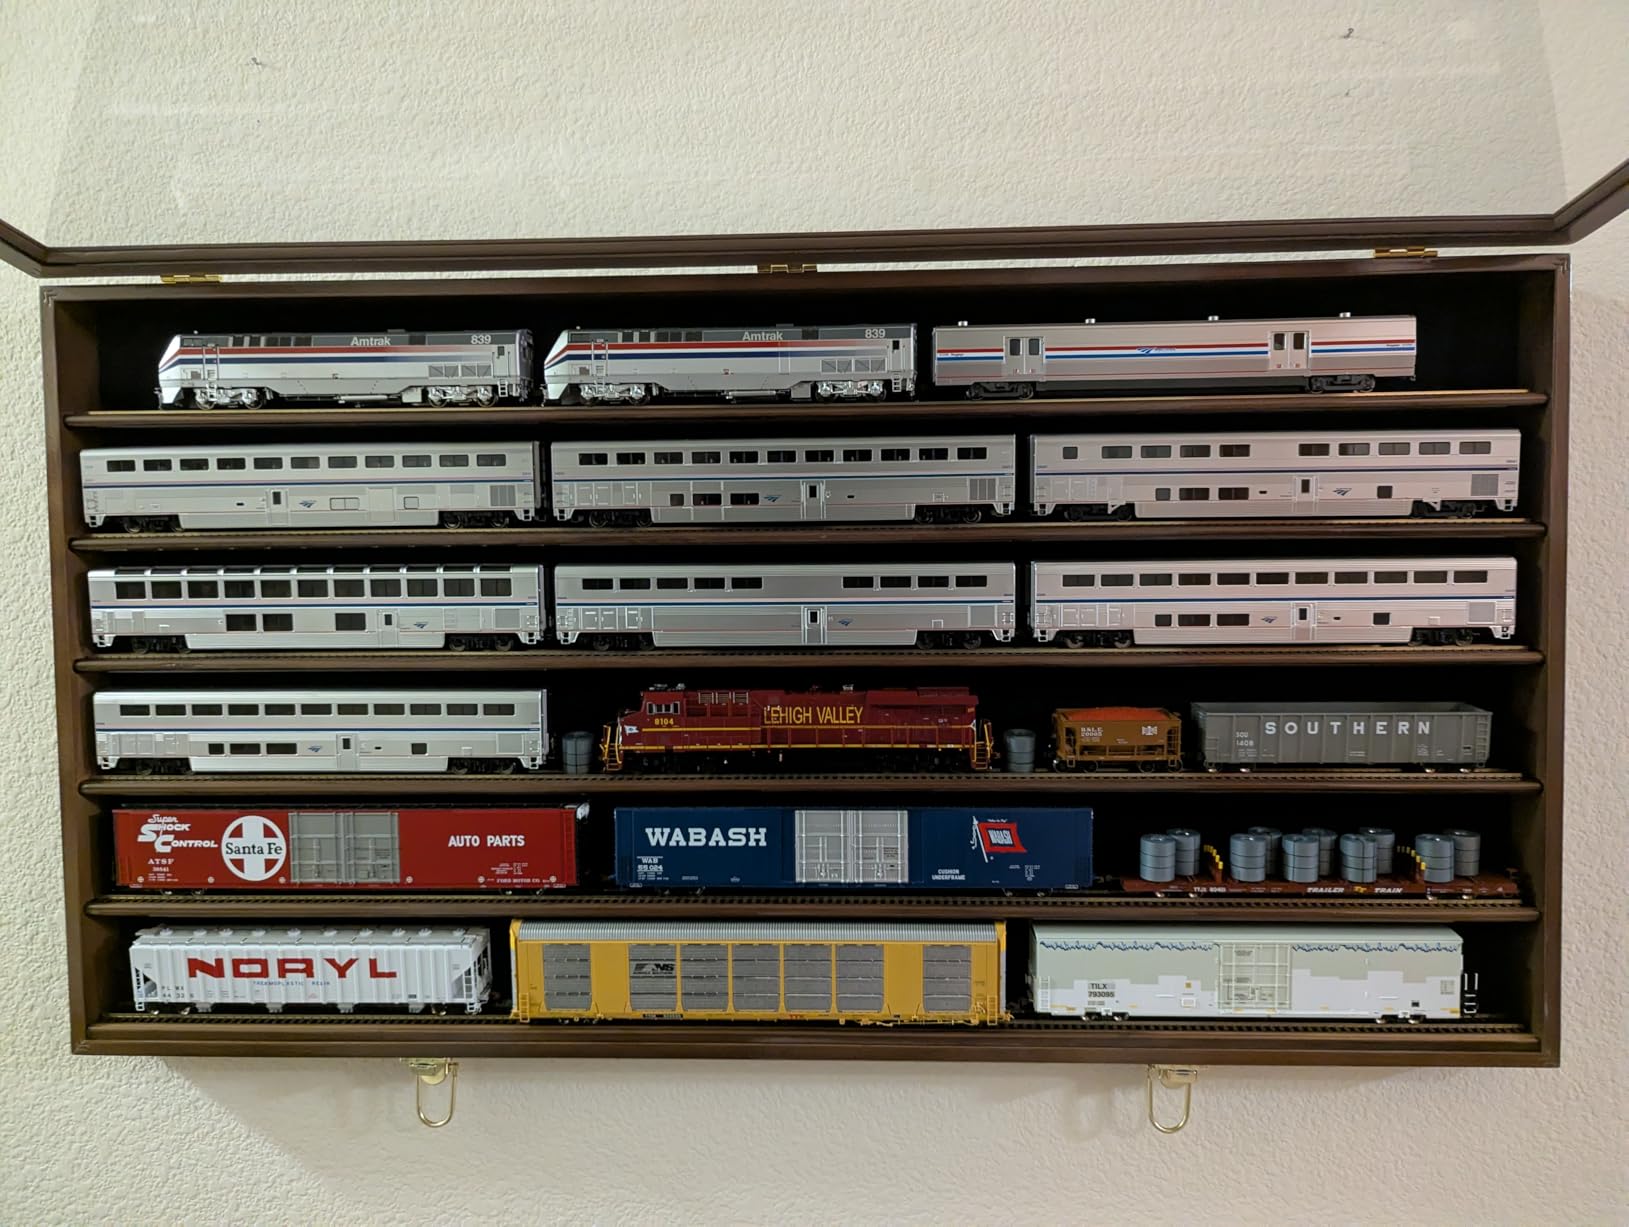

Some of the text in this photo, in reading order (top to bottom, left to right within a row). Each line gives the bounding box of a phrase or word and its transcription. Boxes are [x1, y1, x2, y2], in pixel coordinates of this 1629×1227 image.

[470, 334, 492, 345] 839
[742, 331, 783, 341] Amtrak
[865, 328, 886, 339] 839
[351, 336, 391, 346] Amtrak
[764, 706, 864, 724] LEHIGH VALLEY
[1264, 721, 1430, 735] SOUTHERN
[147, 814, 179, 824] Super
[448, 835, 525, 847] AUTO PARTS
[645, 827, 768, 847] WABASH
[154, 834, 219, 853] CONTROL
[225, 842, 283, 855] Santa Fe
[187, 957, 398, 979] NORYL
